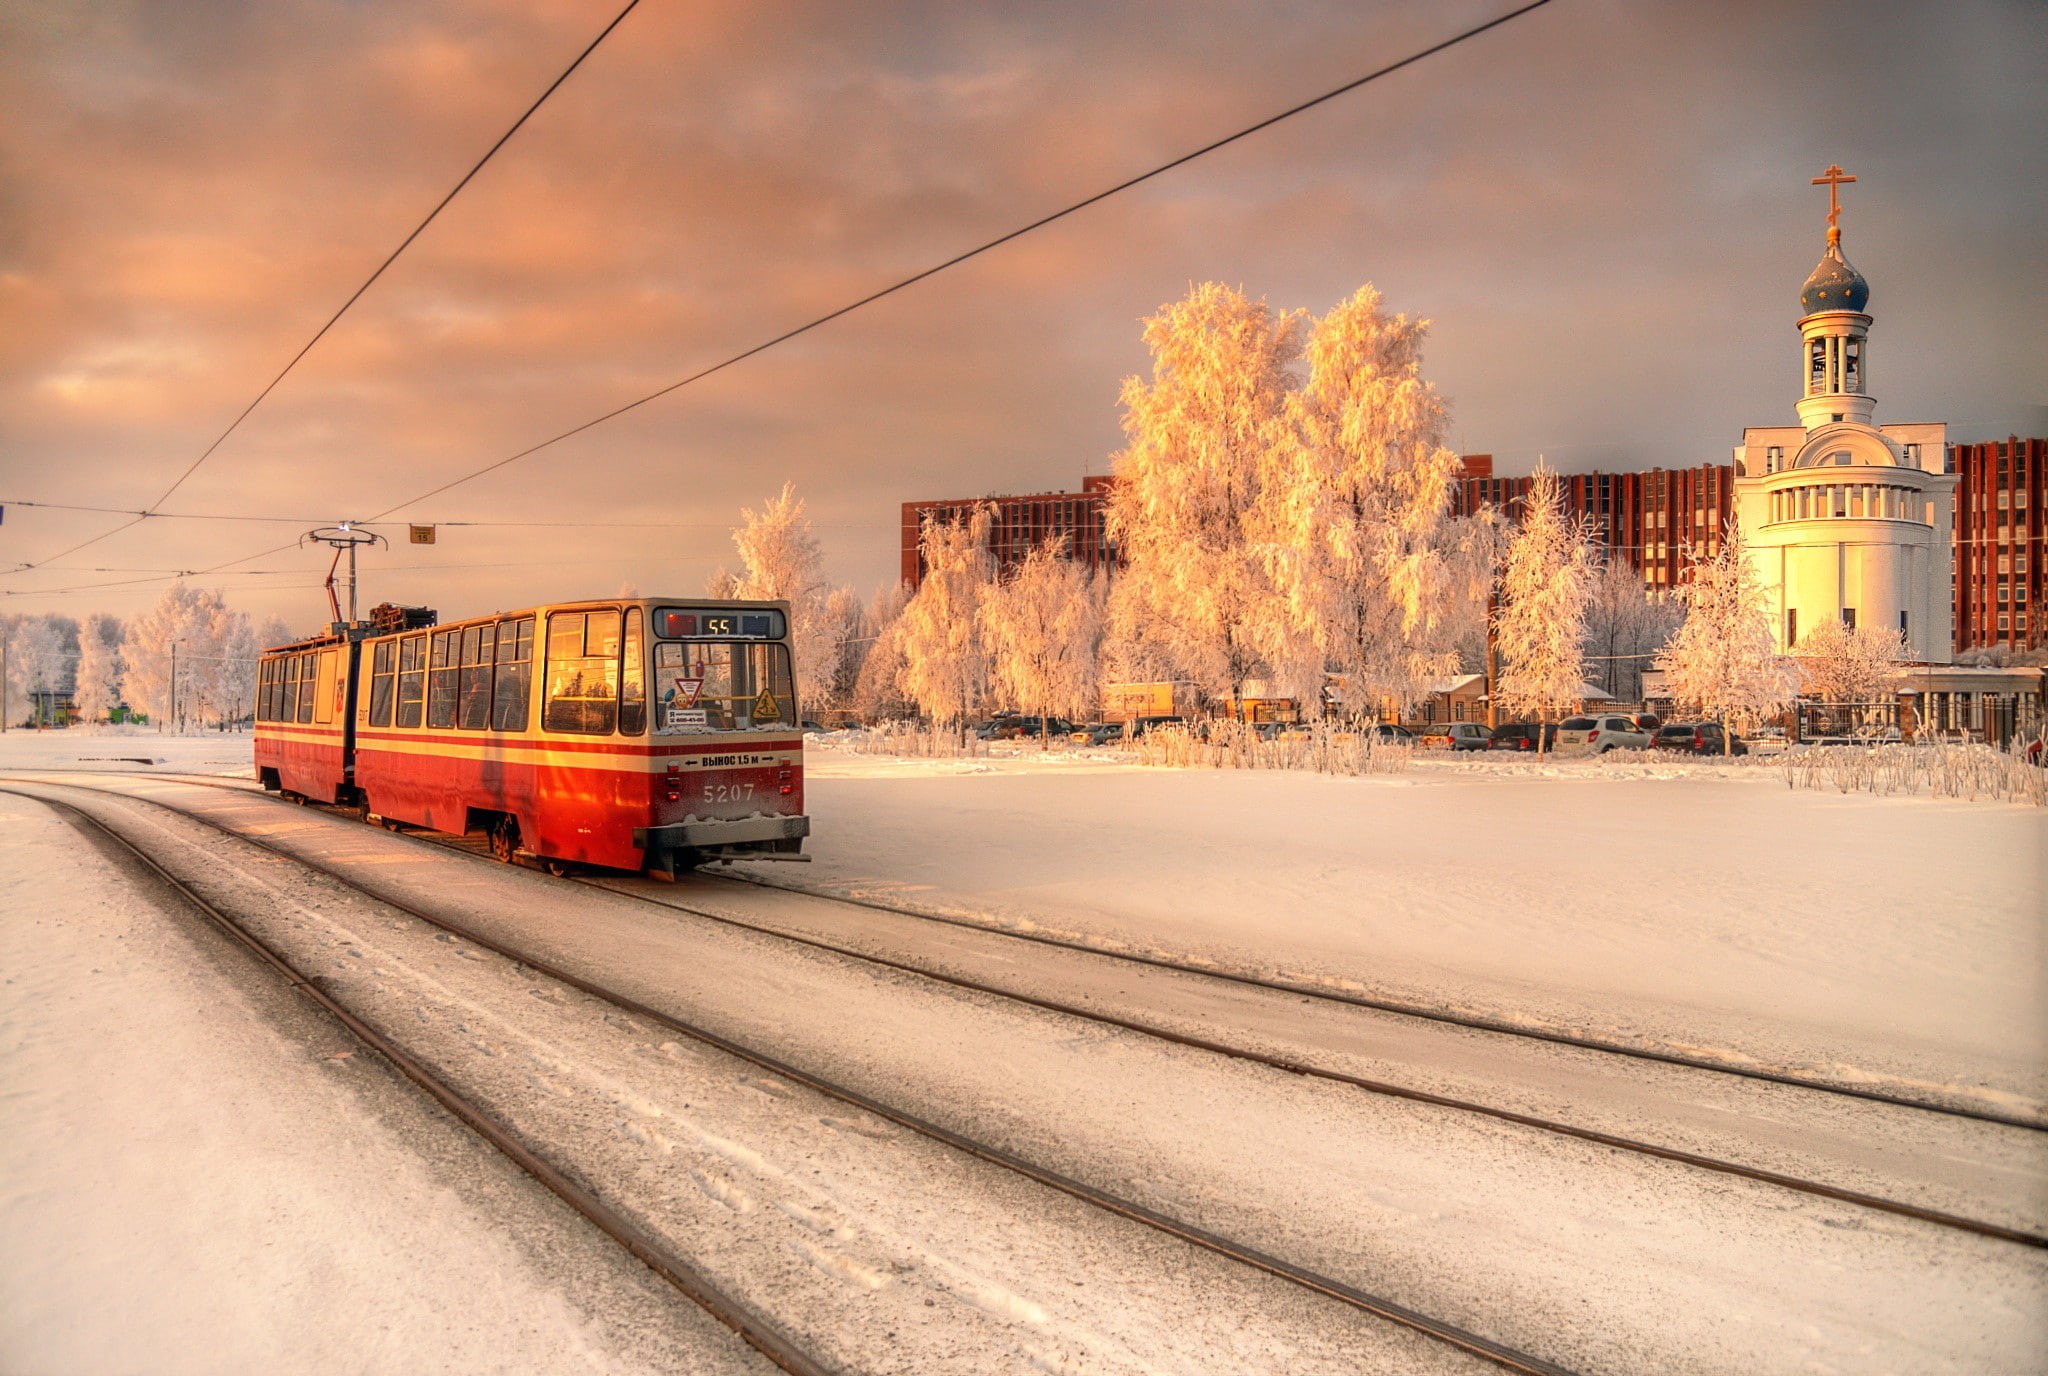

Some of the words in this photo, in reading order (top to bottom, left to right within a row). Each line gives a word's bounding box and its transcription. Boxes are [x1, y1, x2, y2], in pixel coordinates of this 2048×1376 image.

[708, 619, 730, 635] 55
[702, 755, 736, 767] ВЫНОС
[704, 783, 755, 804] 5207
